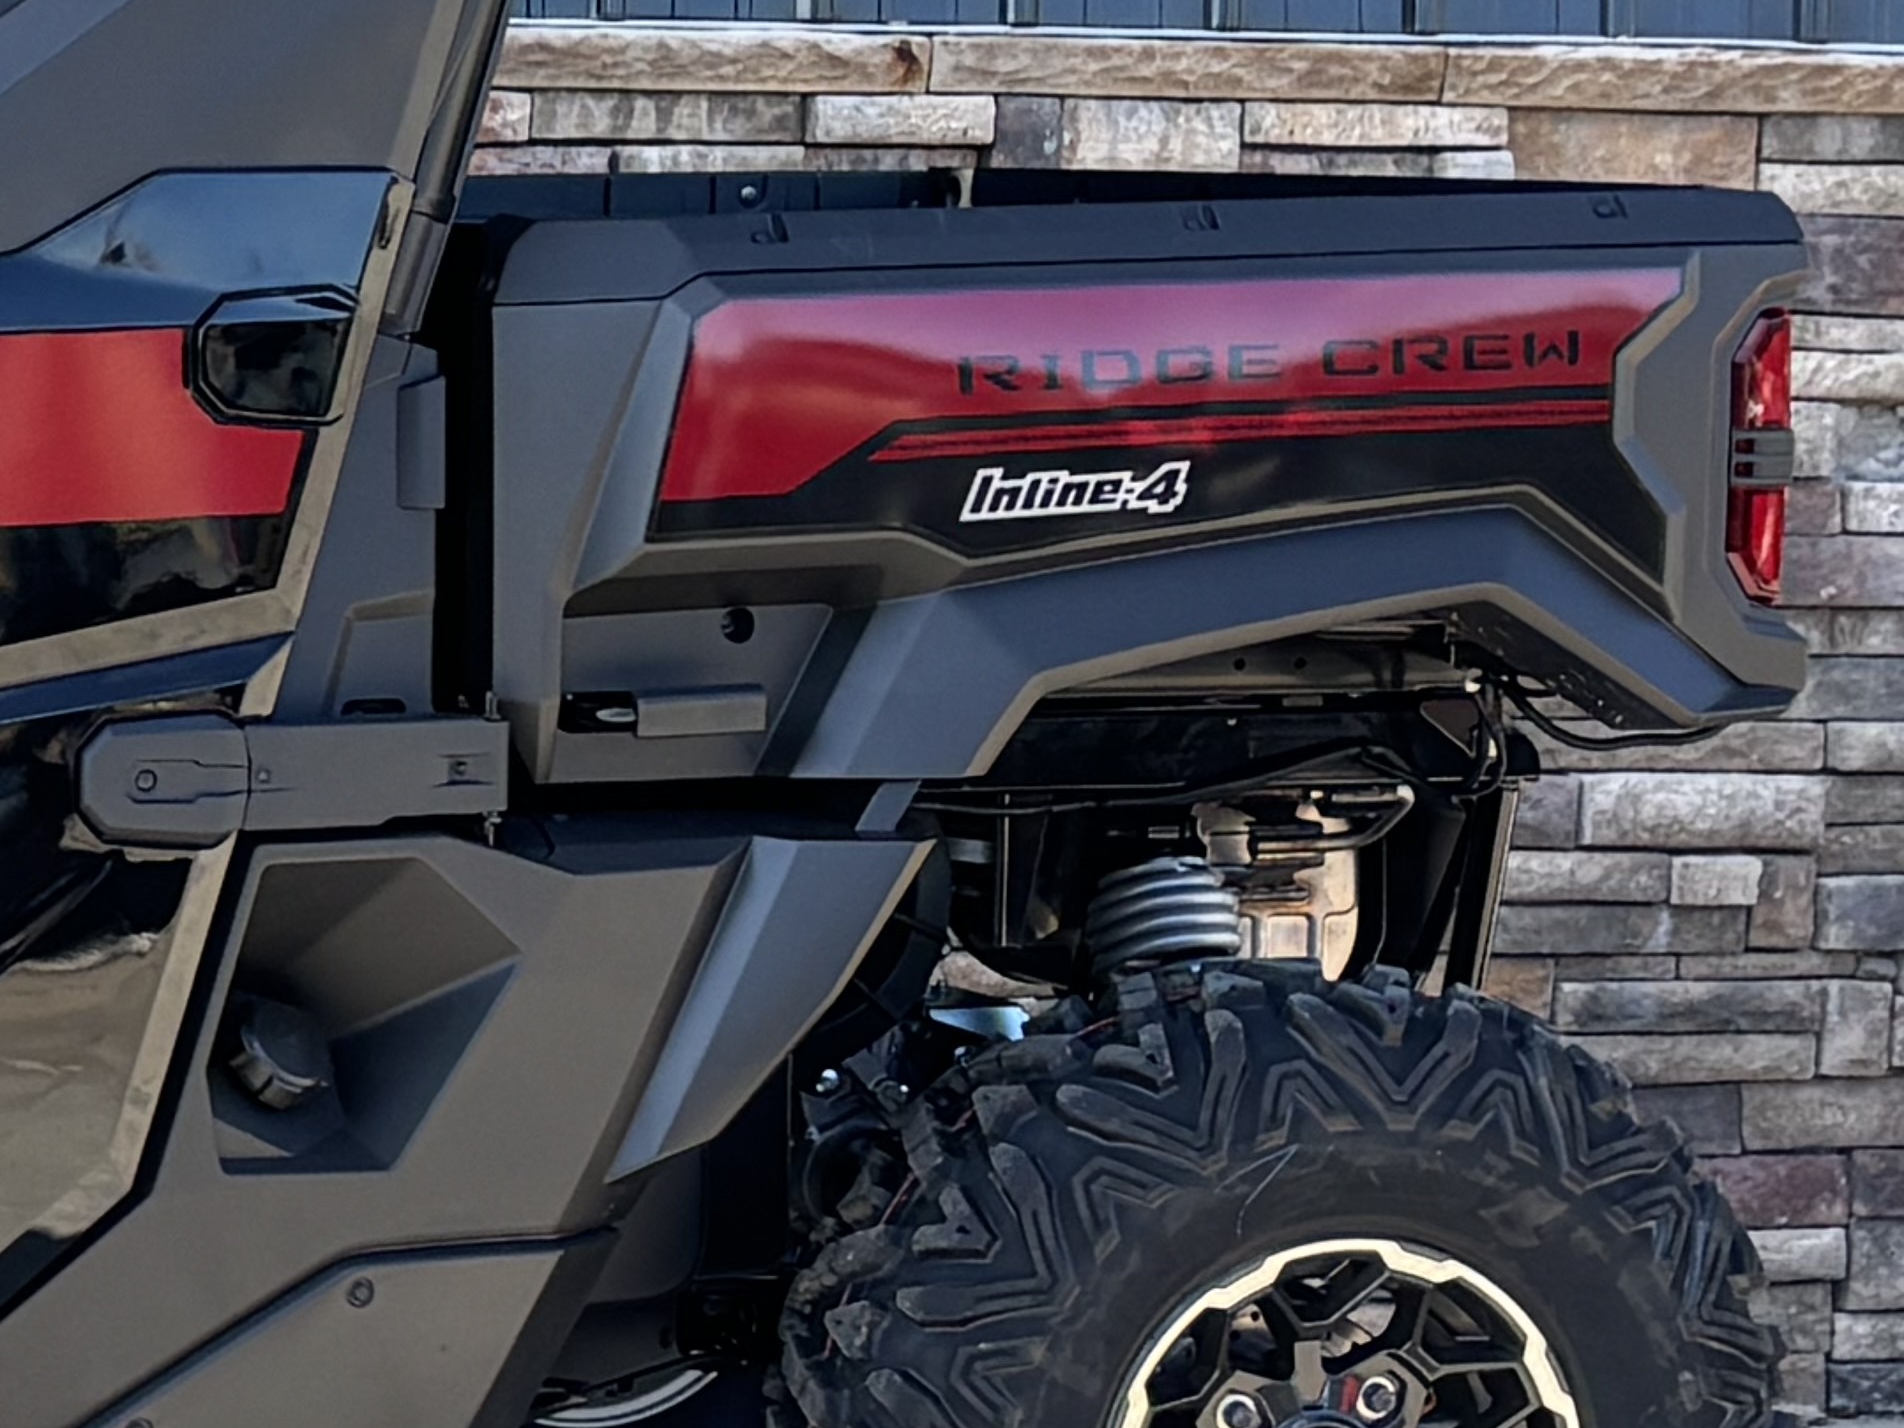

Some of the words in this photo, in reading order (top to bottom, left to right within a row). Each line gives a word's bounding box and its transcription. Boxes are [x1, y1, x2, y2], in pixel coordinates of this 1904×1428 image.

[956, 343, 1280, 396] RIDGE
[1322, 329, 1580, 377] CREW
[960, 461, 1190, 521] Inline-4
